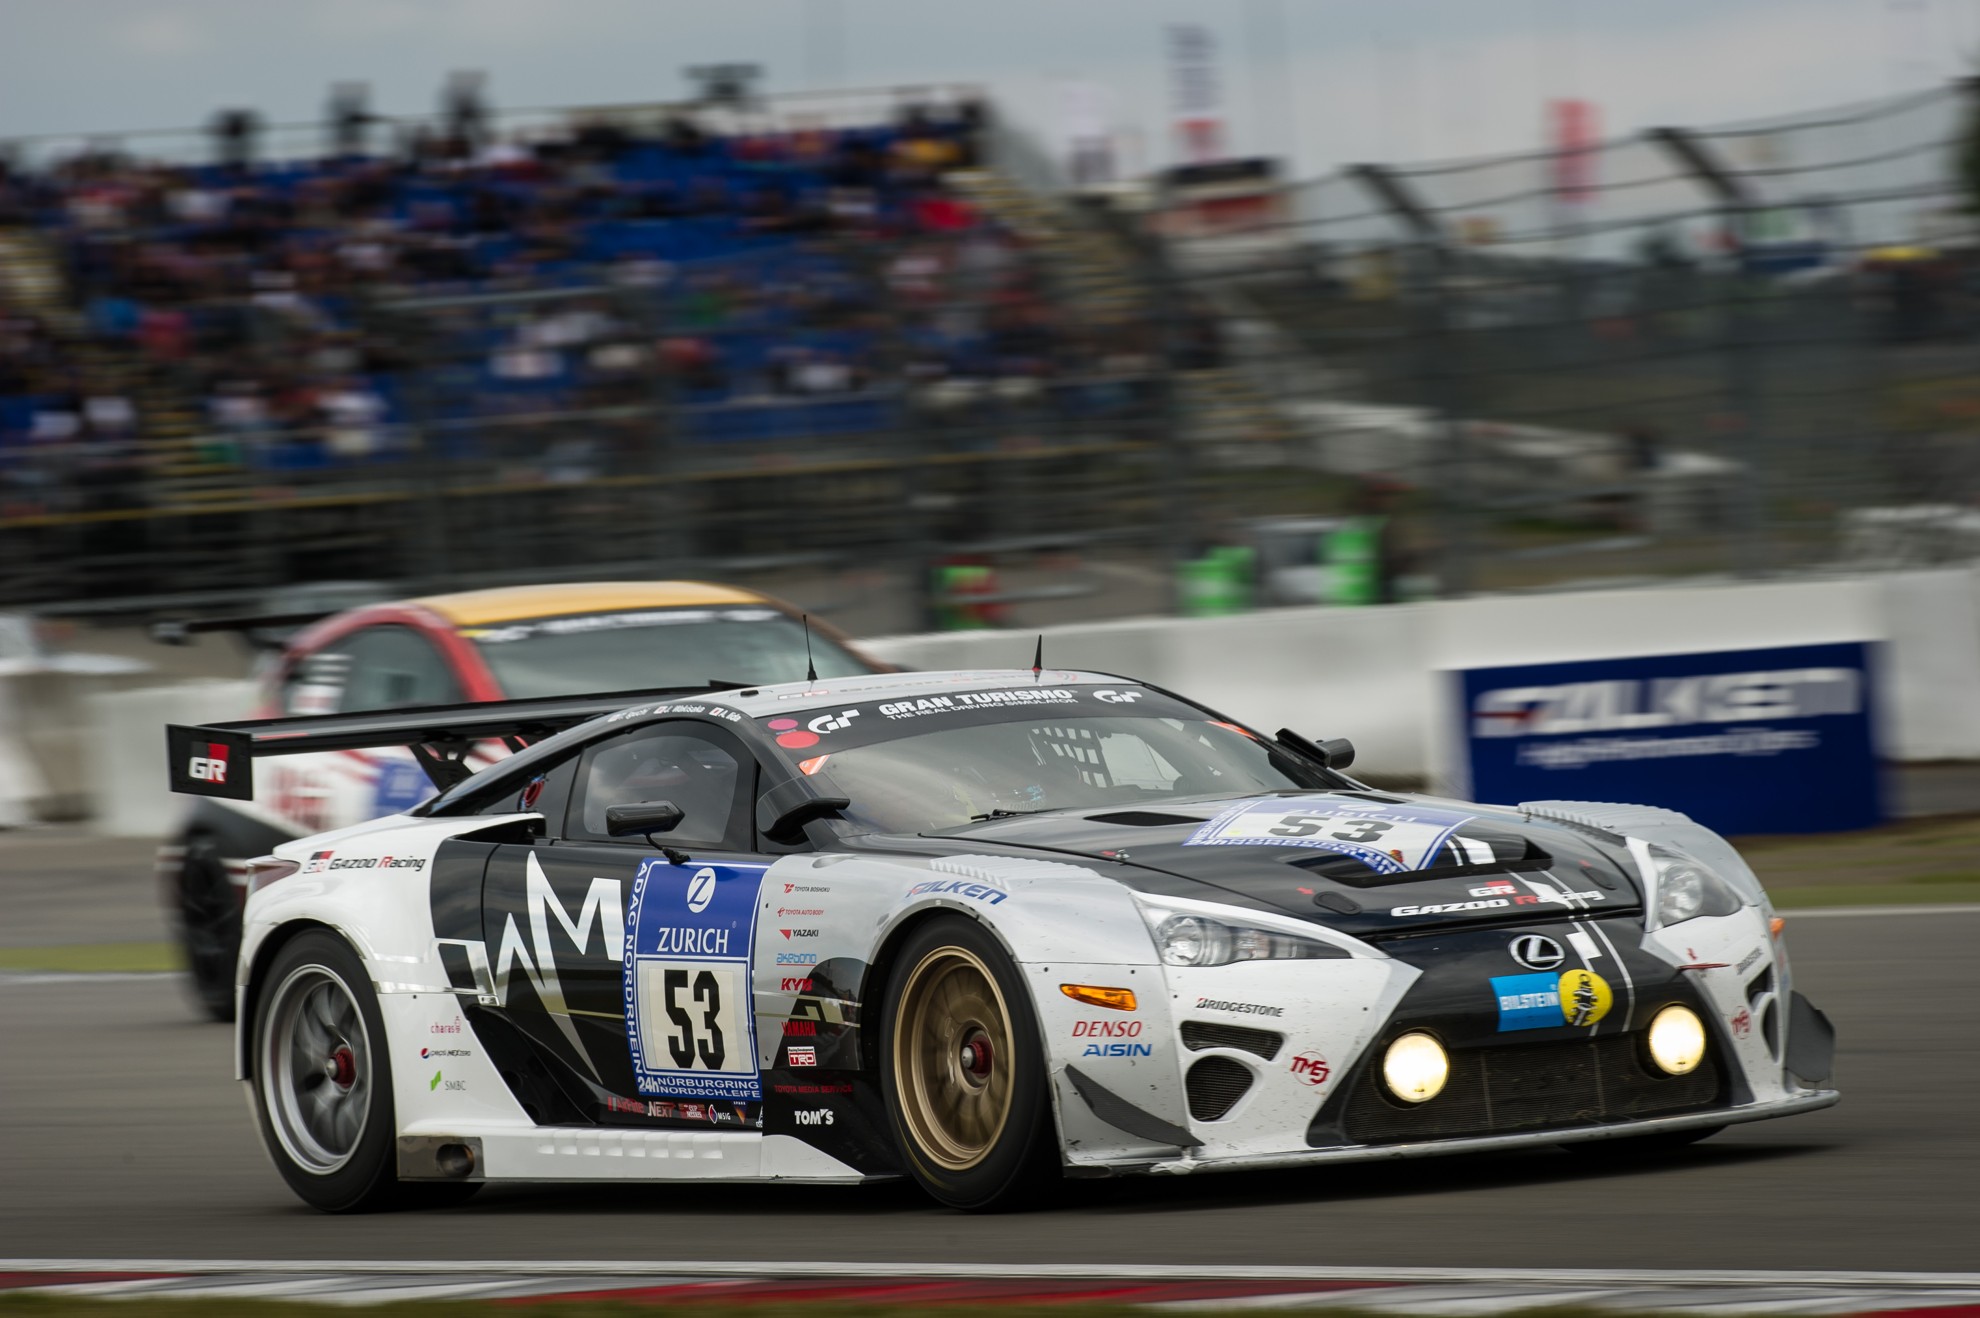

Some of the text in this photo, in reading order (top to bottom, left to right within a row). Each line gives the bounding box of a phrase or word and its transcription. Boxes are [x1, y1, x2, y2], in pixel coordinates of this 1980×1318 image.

[879, 689, 1073, 715] GRAN TURISMO
[915, 707, 951, 717] REAL
[951, 702, 1005, 712] DRIVING
[1004, 698, 1079, 707] SIMULATOR
[188, 756, 228, 782] GR
[1284, 809, 1417, 822] ZURICH
[1268, 816, 1394, 843] 53
[329, 858, 377, 870] GAZOO
[377, 856, 426, 872] Racing
[905, 880, 1008, 905] FALKEN
[1468, 885, 1518, 898] GR
[1391, 898, 1510, 917] GAZOO
[656, 927, 730, 954] ZURICH
[792, 929, 819, 937] YAZAKI
[624, 862, 648, 1074] ADAC NORDRHEIN
[781, 978, 813, 991] KYB
[664, 969, 726, 1070] 53
[781, 1021, 817, 1036] YAMAHA
[1072, 1021, 1142, 1037] DENSO
[1082, 1043, 1152, 1057] AISIN
[444, 1081, 467, 1091] SMBC
[637, 1076, 759, 1093] 24h NÜRBURGRING
[659, 1086, 761, 1098] NORDSCHLEIFE
[774, 1084, 797, 1093] TOYOTA
[794, 1108, 834, 1125] TOM'S
